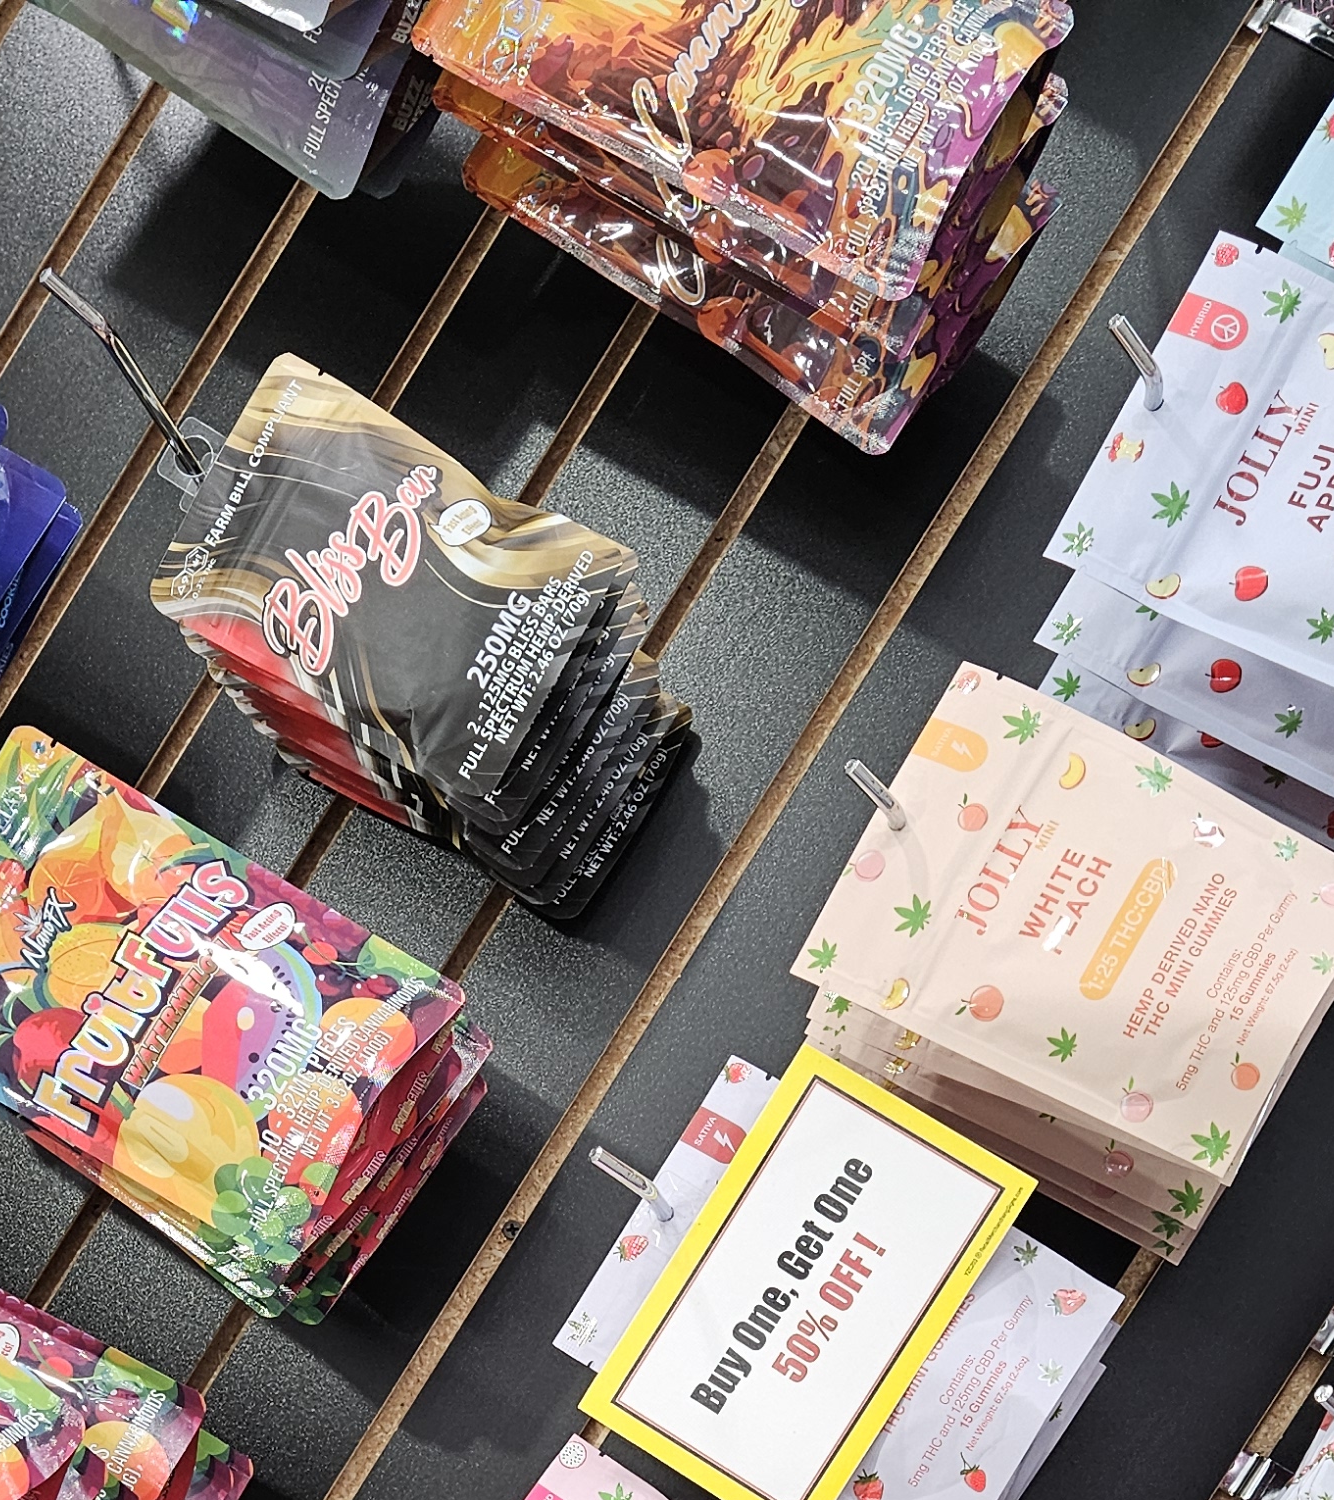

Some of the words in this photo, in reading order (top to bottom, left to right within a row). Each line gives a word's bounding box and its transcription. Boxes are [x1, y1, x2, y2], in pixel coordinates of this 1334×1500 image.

[841, 19, 924, 126] 320MG
[302, 121, 328, 159] FULL
[1188, 299, 1214, 337] HYBRID
[202, 501, 237, 547] FARM
[227, 468, 256, 505] BILL
[246, 378, 305, 470] COMPLIANT
[1210, 387, 1306, 528] JOLLY
[1294, 400, 1320, 435] MINI
[262, 534, 368, 673] Bliss
[347, 466, 442, 585] Bar
[463, 589, 534, 689] 250MG
[493, 710, 519, 745] NET
[509, 679, 538, 717] WT:
[527, 646, 556, 684] 2.46
[546, 622, 569, 650] OZ
[559, 585, 594, 628] (70g)
[952, 803, 1048, 936] JOLLY
[1019, 845, 1087, 942] WHITE
[1042, 853, 1114, 957] EACH
[244, 1013, 323, 1112] 320MG
[693, 1114, 717, 1147] SATIVA
[689, 1345, 756, 1415] Buy
[730, 1274, 801, 1355] One,
[773, 1215, 836, 1284] Get
[811, 1151, 876, 1225] One
[770, 1304, 840, 1385] 50%
[815, 1248, 876, 1313] OFF
[852, 1231, 887, 1256] !
[938, 1352, 977, 1406] Contains:
[959, 1412, 976, 1430] 15
[968, 1358, 1008, 1416] Gummies
